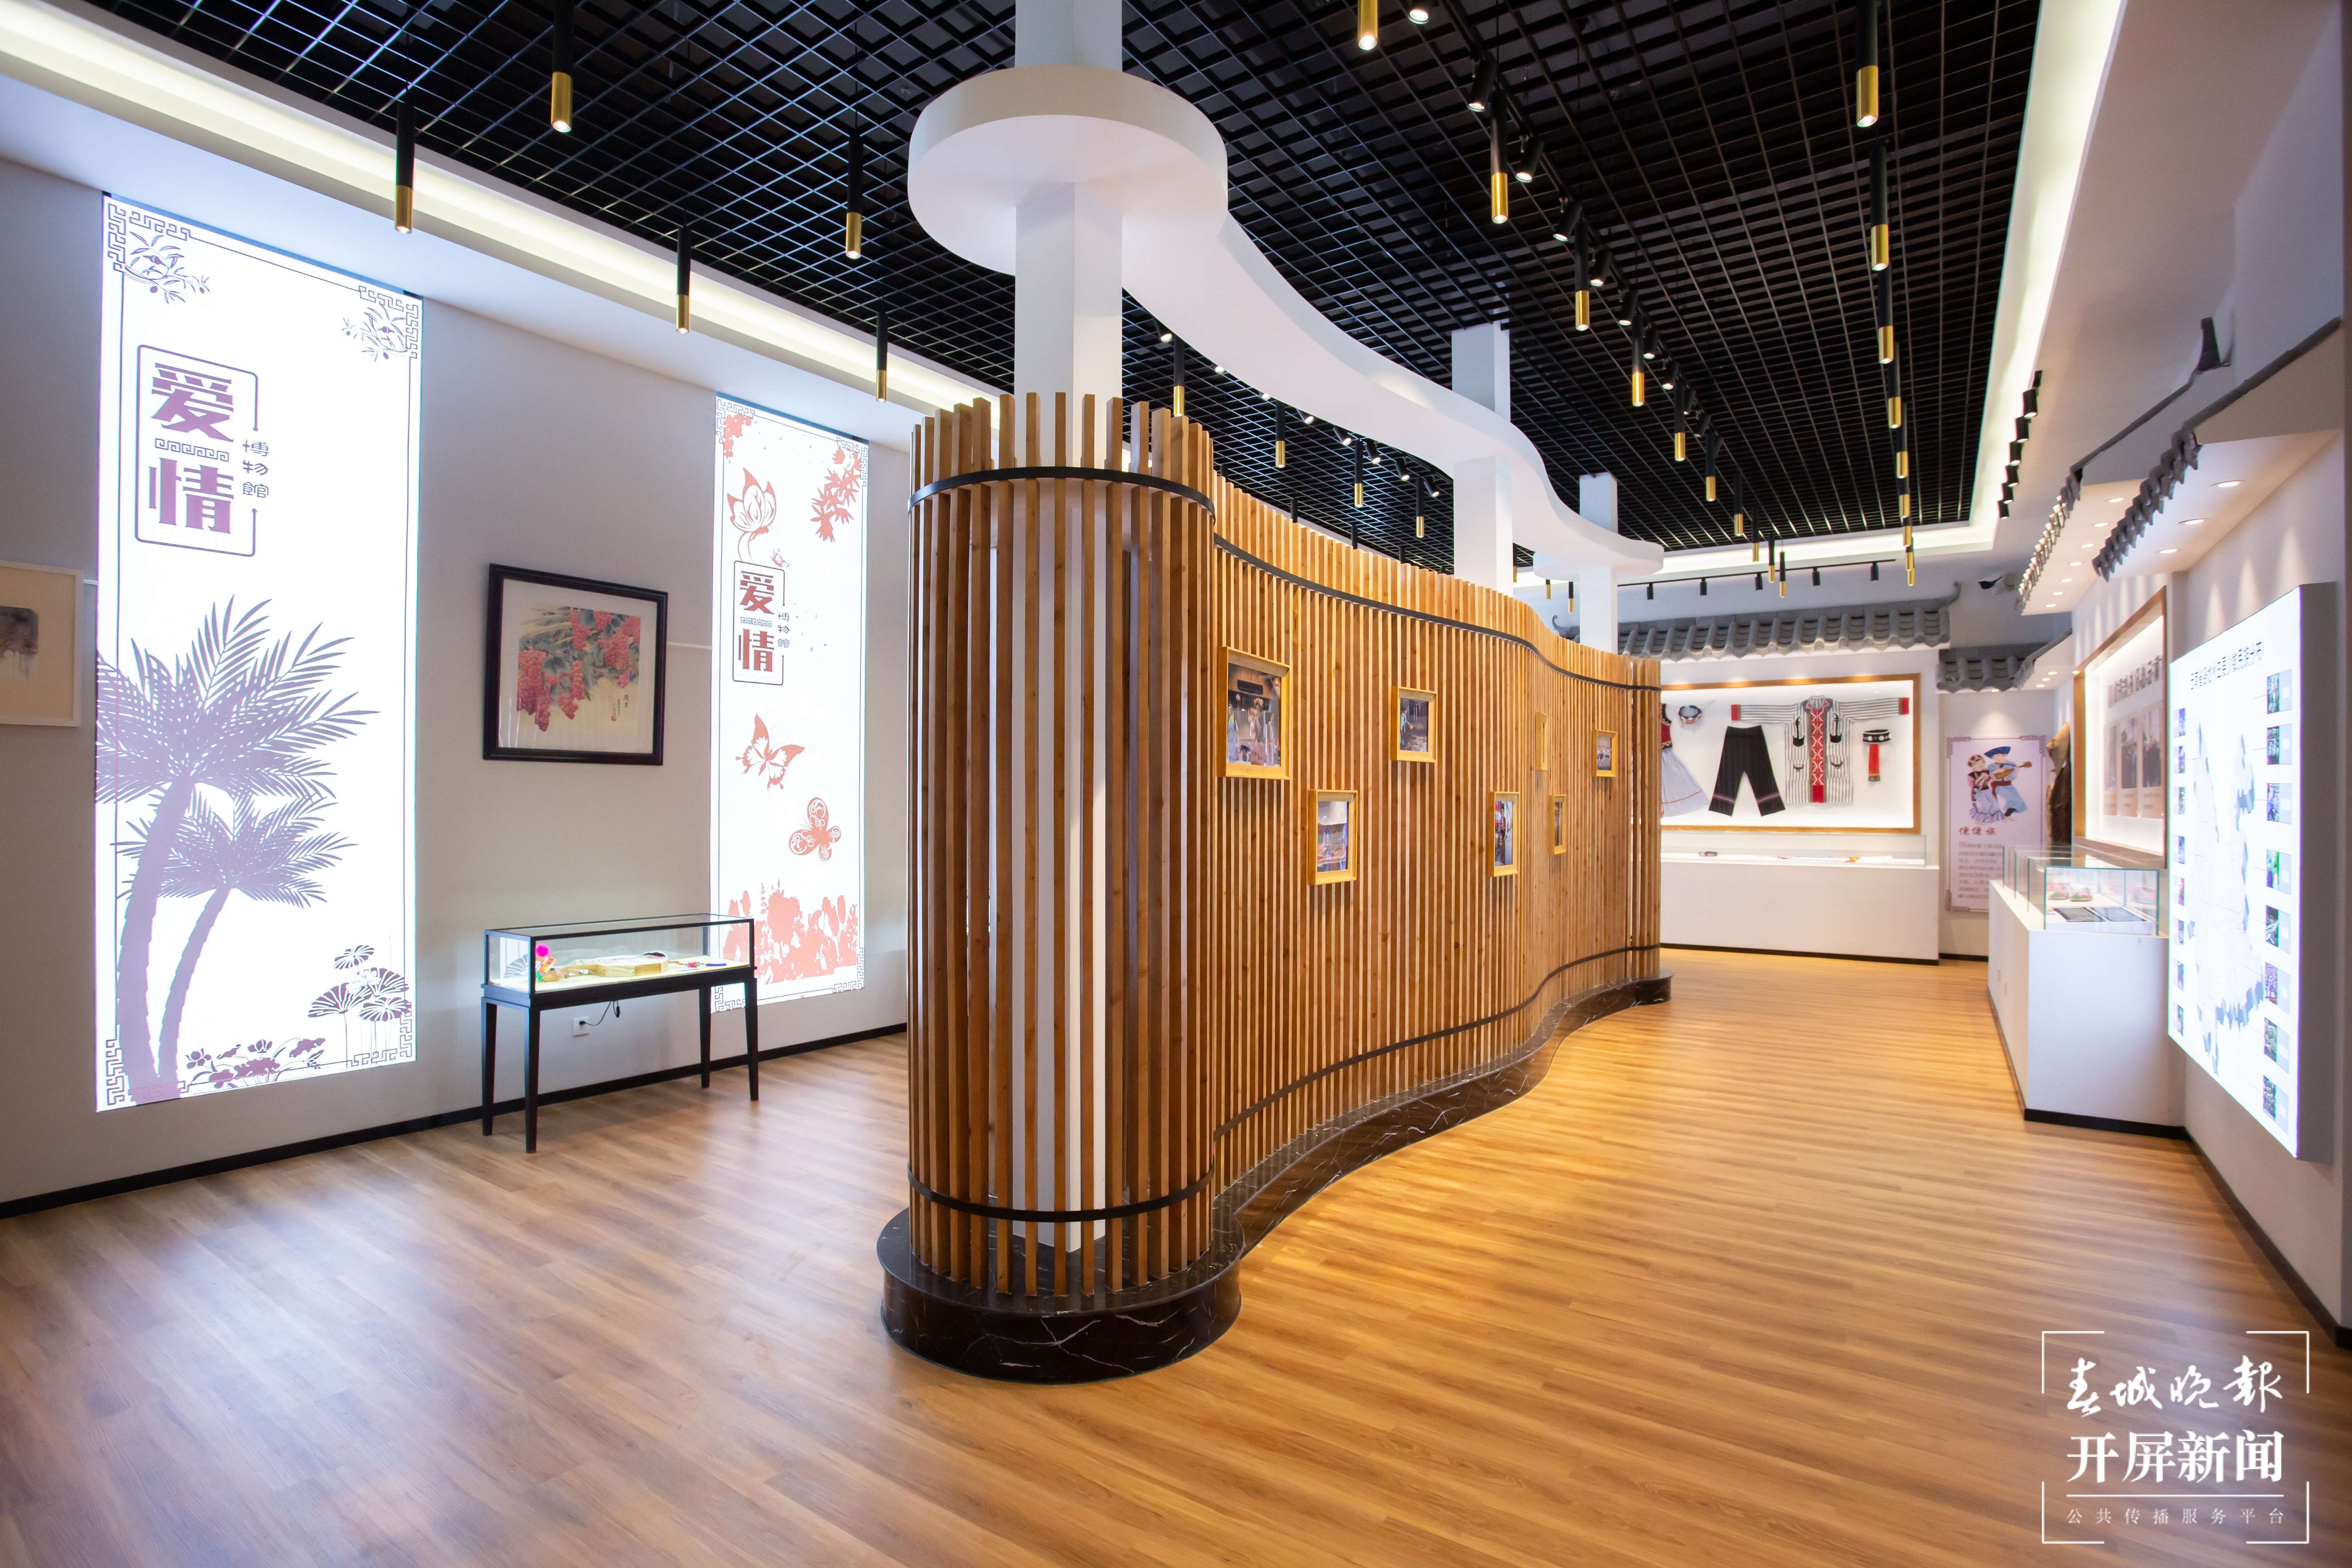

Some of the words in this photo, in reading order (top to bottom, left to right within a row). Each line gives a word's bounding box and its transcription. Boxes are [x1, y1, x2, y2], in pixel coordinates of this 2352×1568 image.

[149, 362, 234, 534] 爱情
[242, 439, 270, 499] 博物館
[738, 570, 774, 673] 爱情
[777, 611, 790, 648] 博物館
